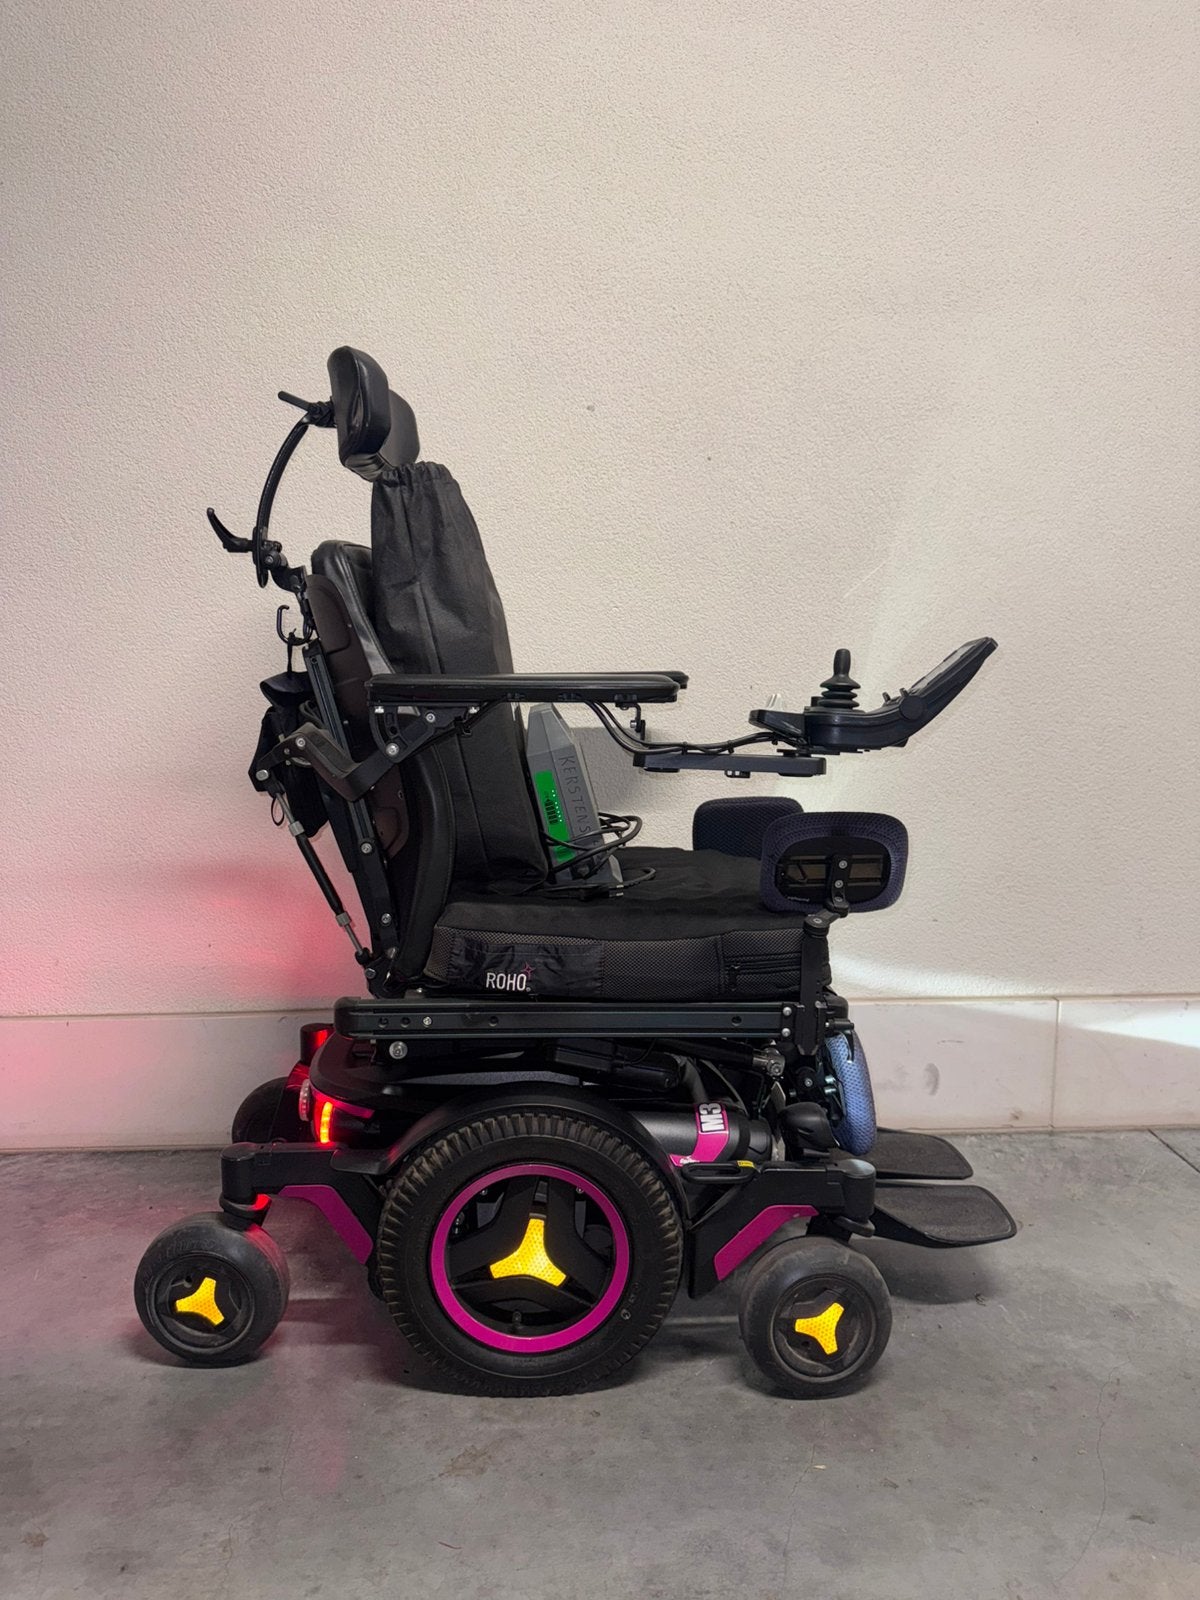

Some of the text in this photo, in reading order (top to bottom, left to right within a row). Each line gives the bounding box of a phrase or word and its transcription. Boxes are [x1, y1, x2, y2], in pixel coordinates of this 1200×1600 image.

[558, 754, 591, 834] KERSTENS
[486, 972, 528, 992] ROHO
[698, 1103, 725, 1132] M3
